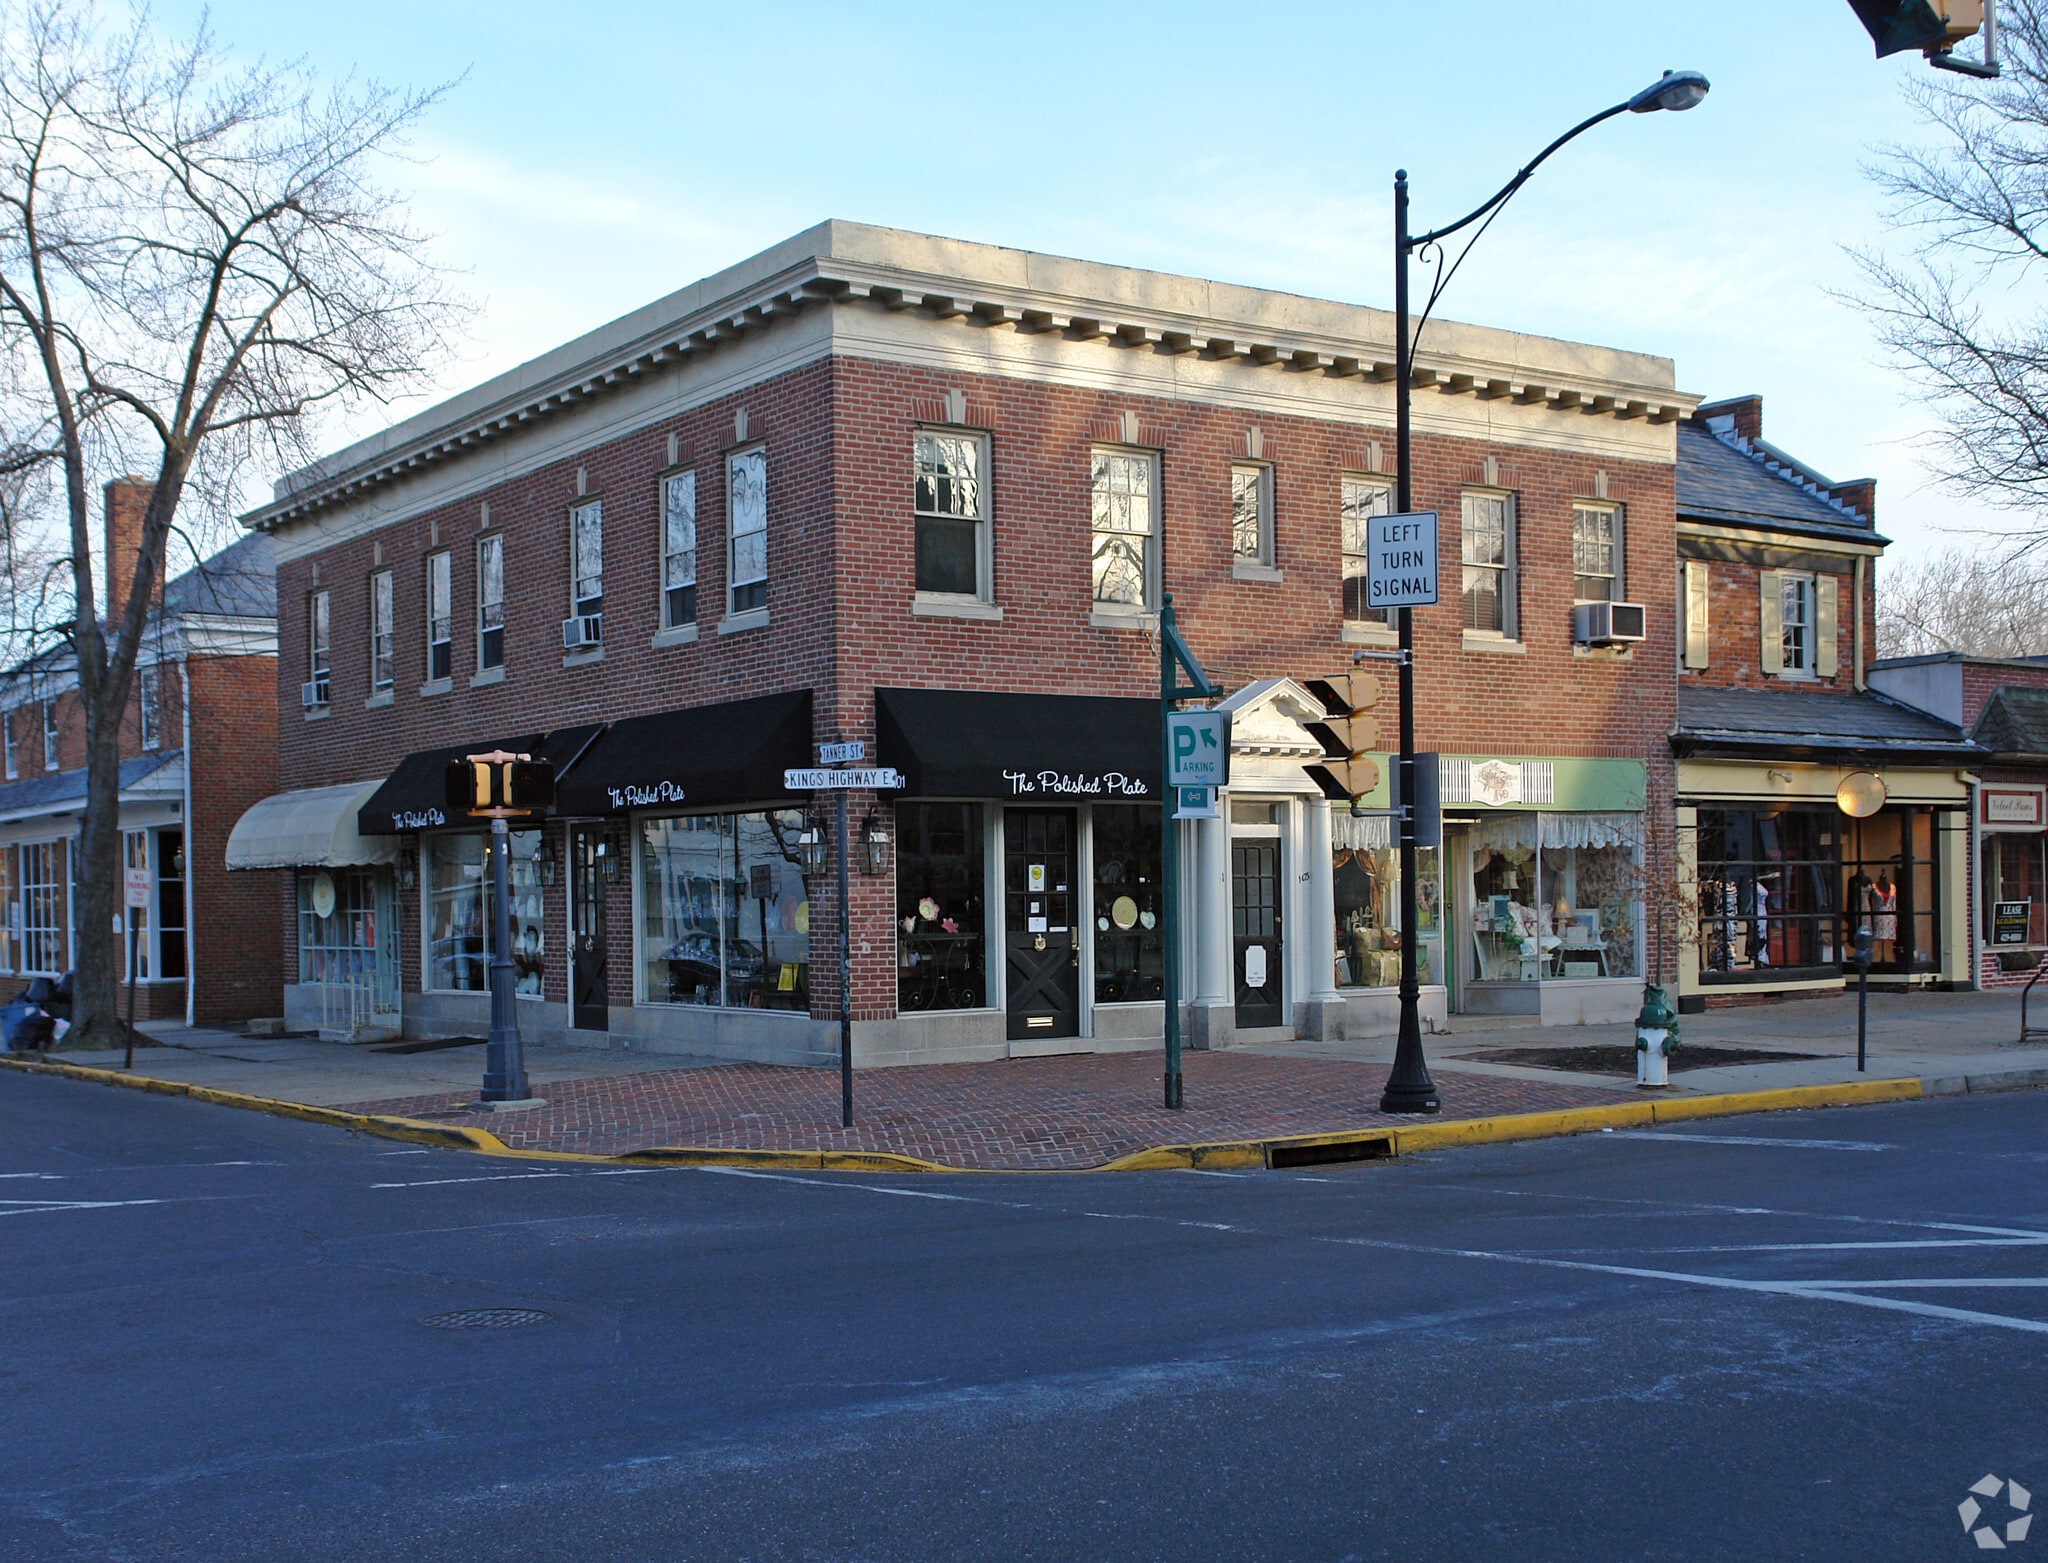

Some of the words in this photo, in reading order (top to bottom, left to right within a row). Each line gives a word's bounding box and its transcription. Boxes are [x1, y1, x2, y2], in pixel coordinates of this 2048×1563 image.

[1383, 524, 1420, 542] LEFT
[1381, 550, 1423, 569] TURN
[1373, 577, 1432, 597] SIGNAL
[822, 745, 846, 760] TANNER
[850, 744, 859, 758] ST
[789, 772, 824, 787] KINGS
[828, 771, 877, 786] HIGHWAY
[1002, 769, 1035, 794] The
[1036, 770, 1101, 794] Polished
[1103, 772, 1148, 794] Plate
[607, 786, 624, 809] The
[624, 785, 660, 806] Polished
[660, 780, 685, 802] Plate
[134, 873, 145, 882] NO
[2003, 904, 2023, 915] LEASE
